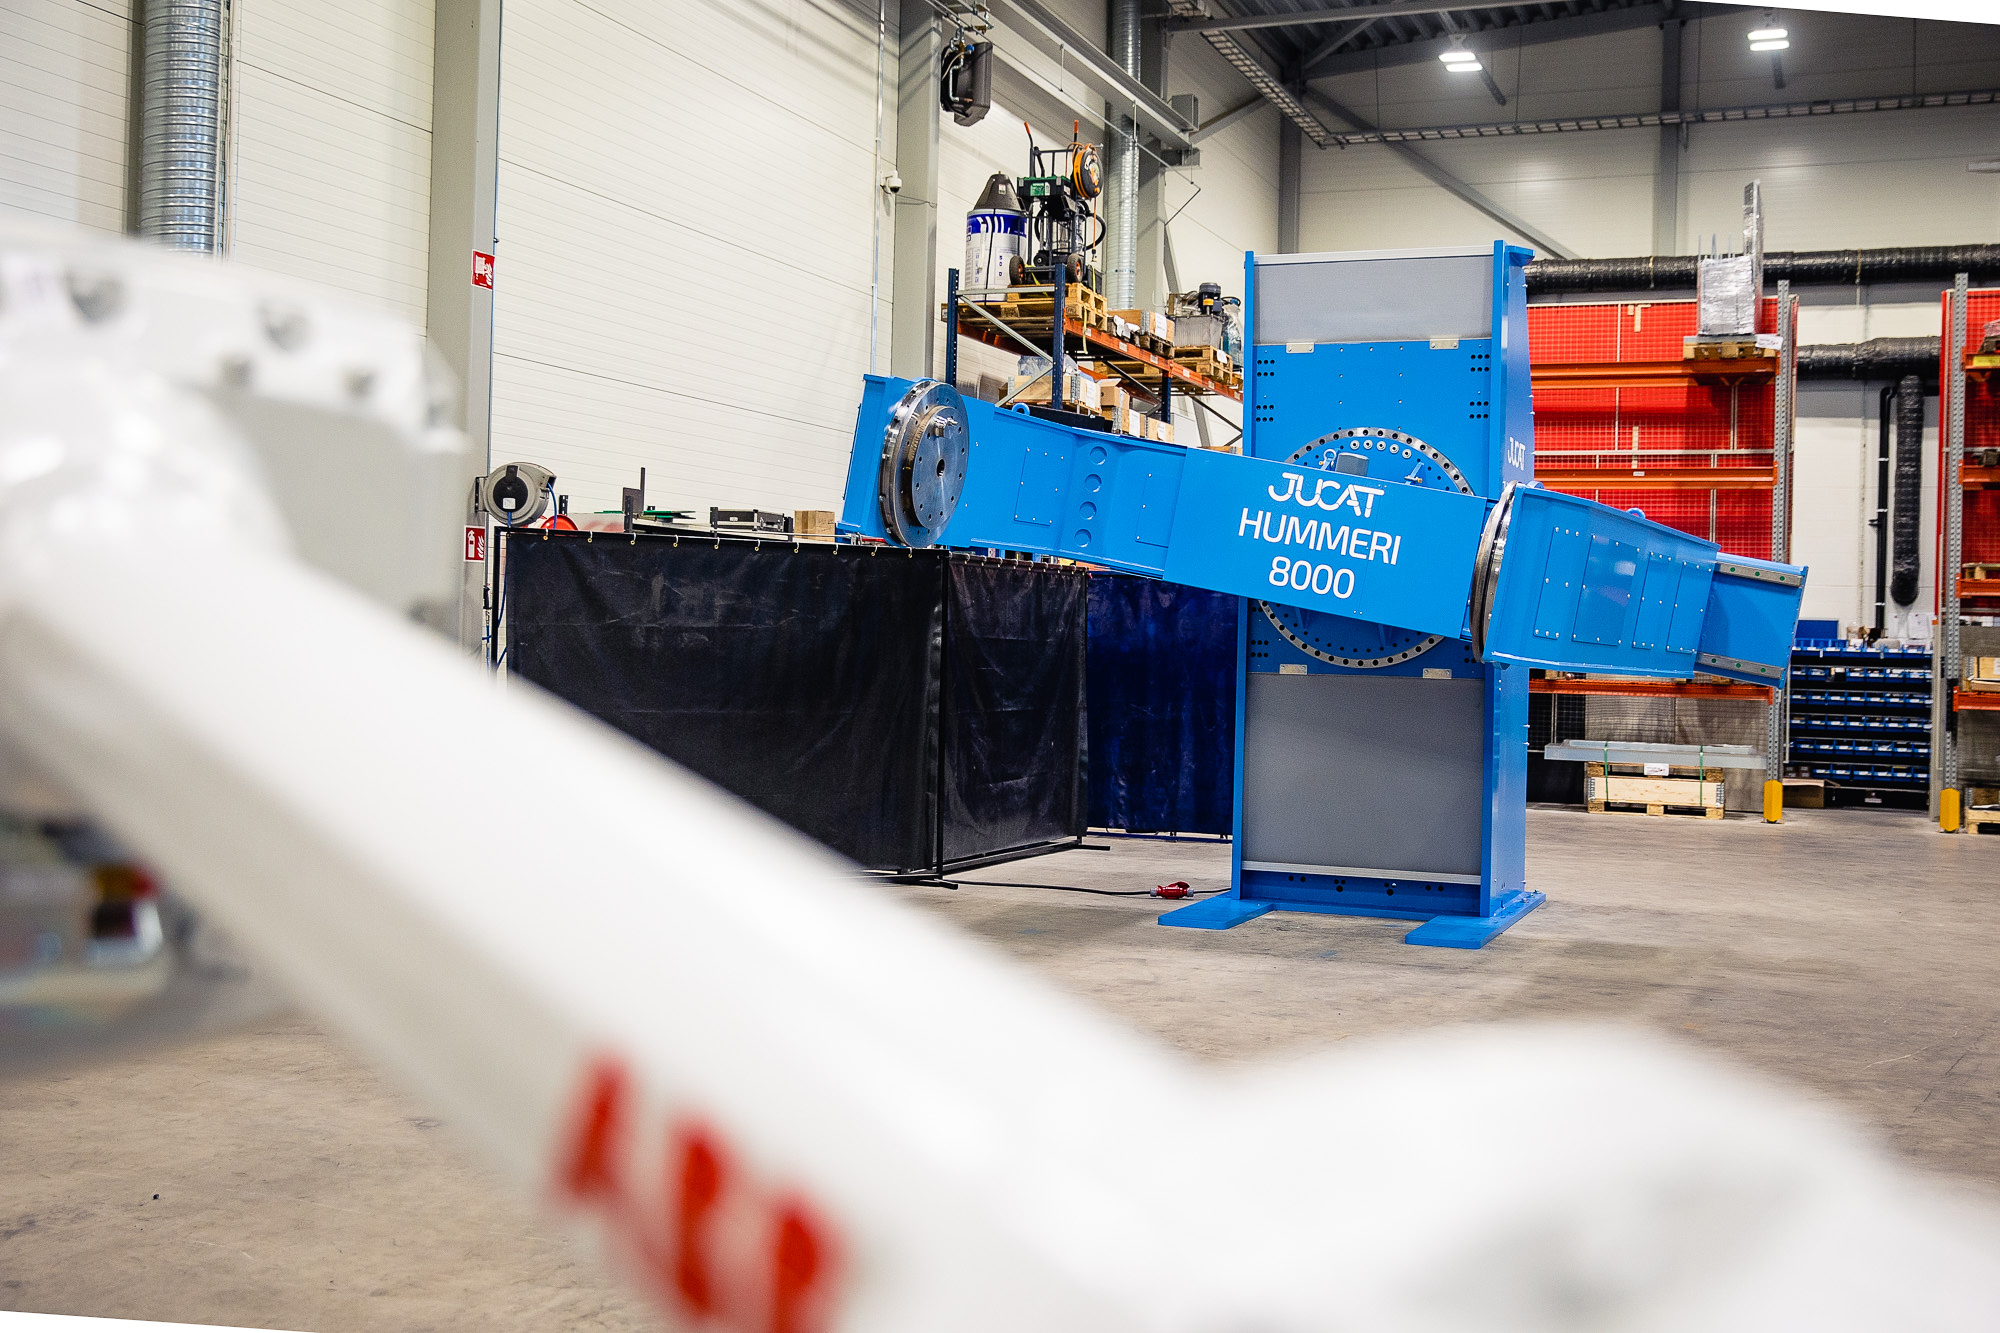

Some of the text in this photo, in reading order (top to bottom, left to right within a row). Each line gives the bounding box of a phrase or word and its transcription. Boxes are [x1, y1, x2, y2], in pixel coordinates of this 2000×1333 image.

[1507, 436, 1526, 471] JUCAT
[1268, 471, 1385, 518] JUCAT
[1238, 507, 1402, 566] HUMMERI
[1268, 556, 1356, 600] 8000
